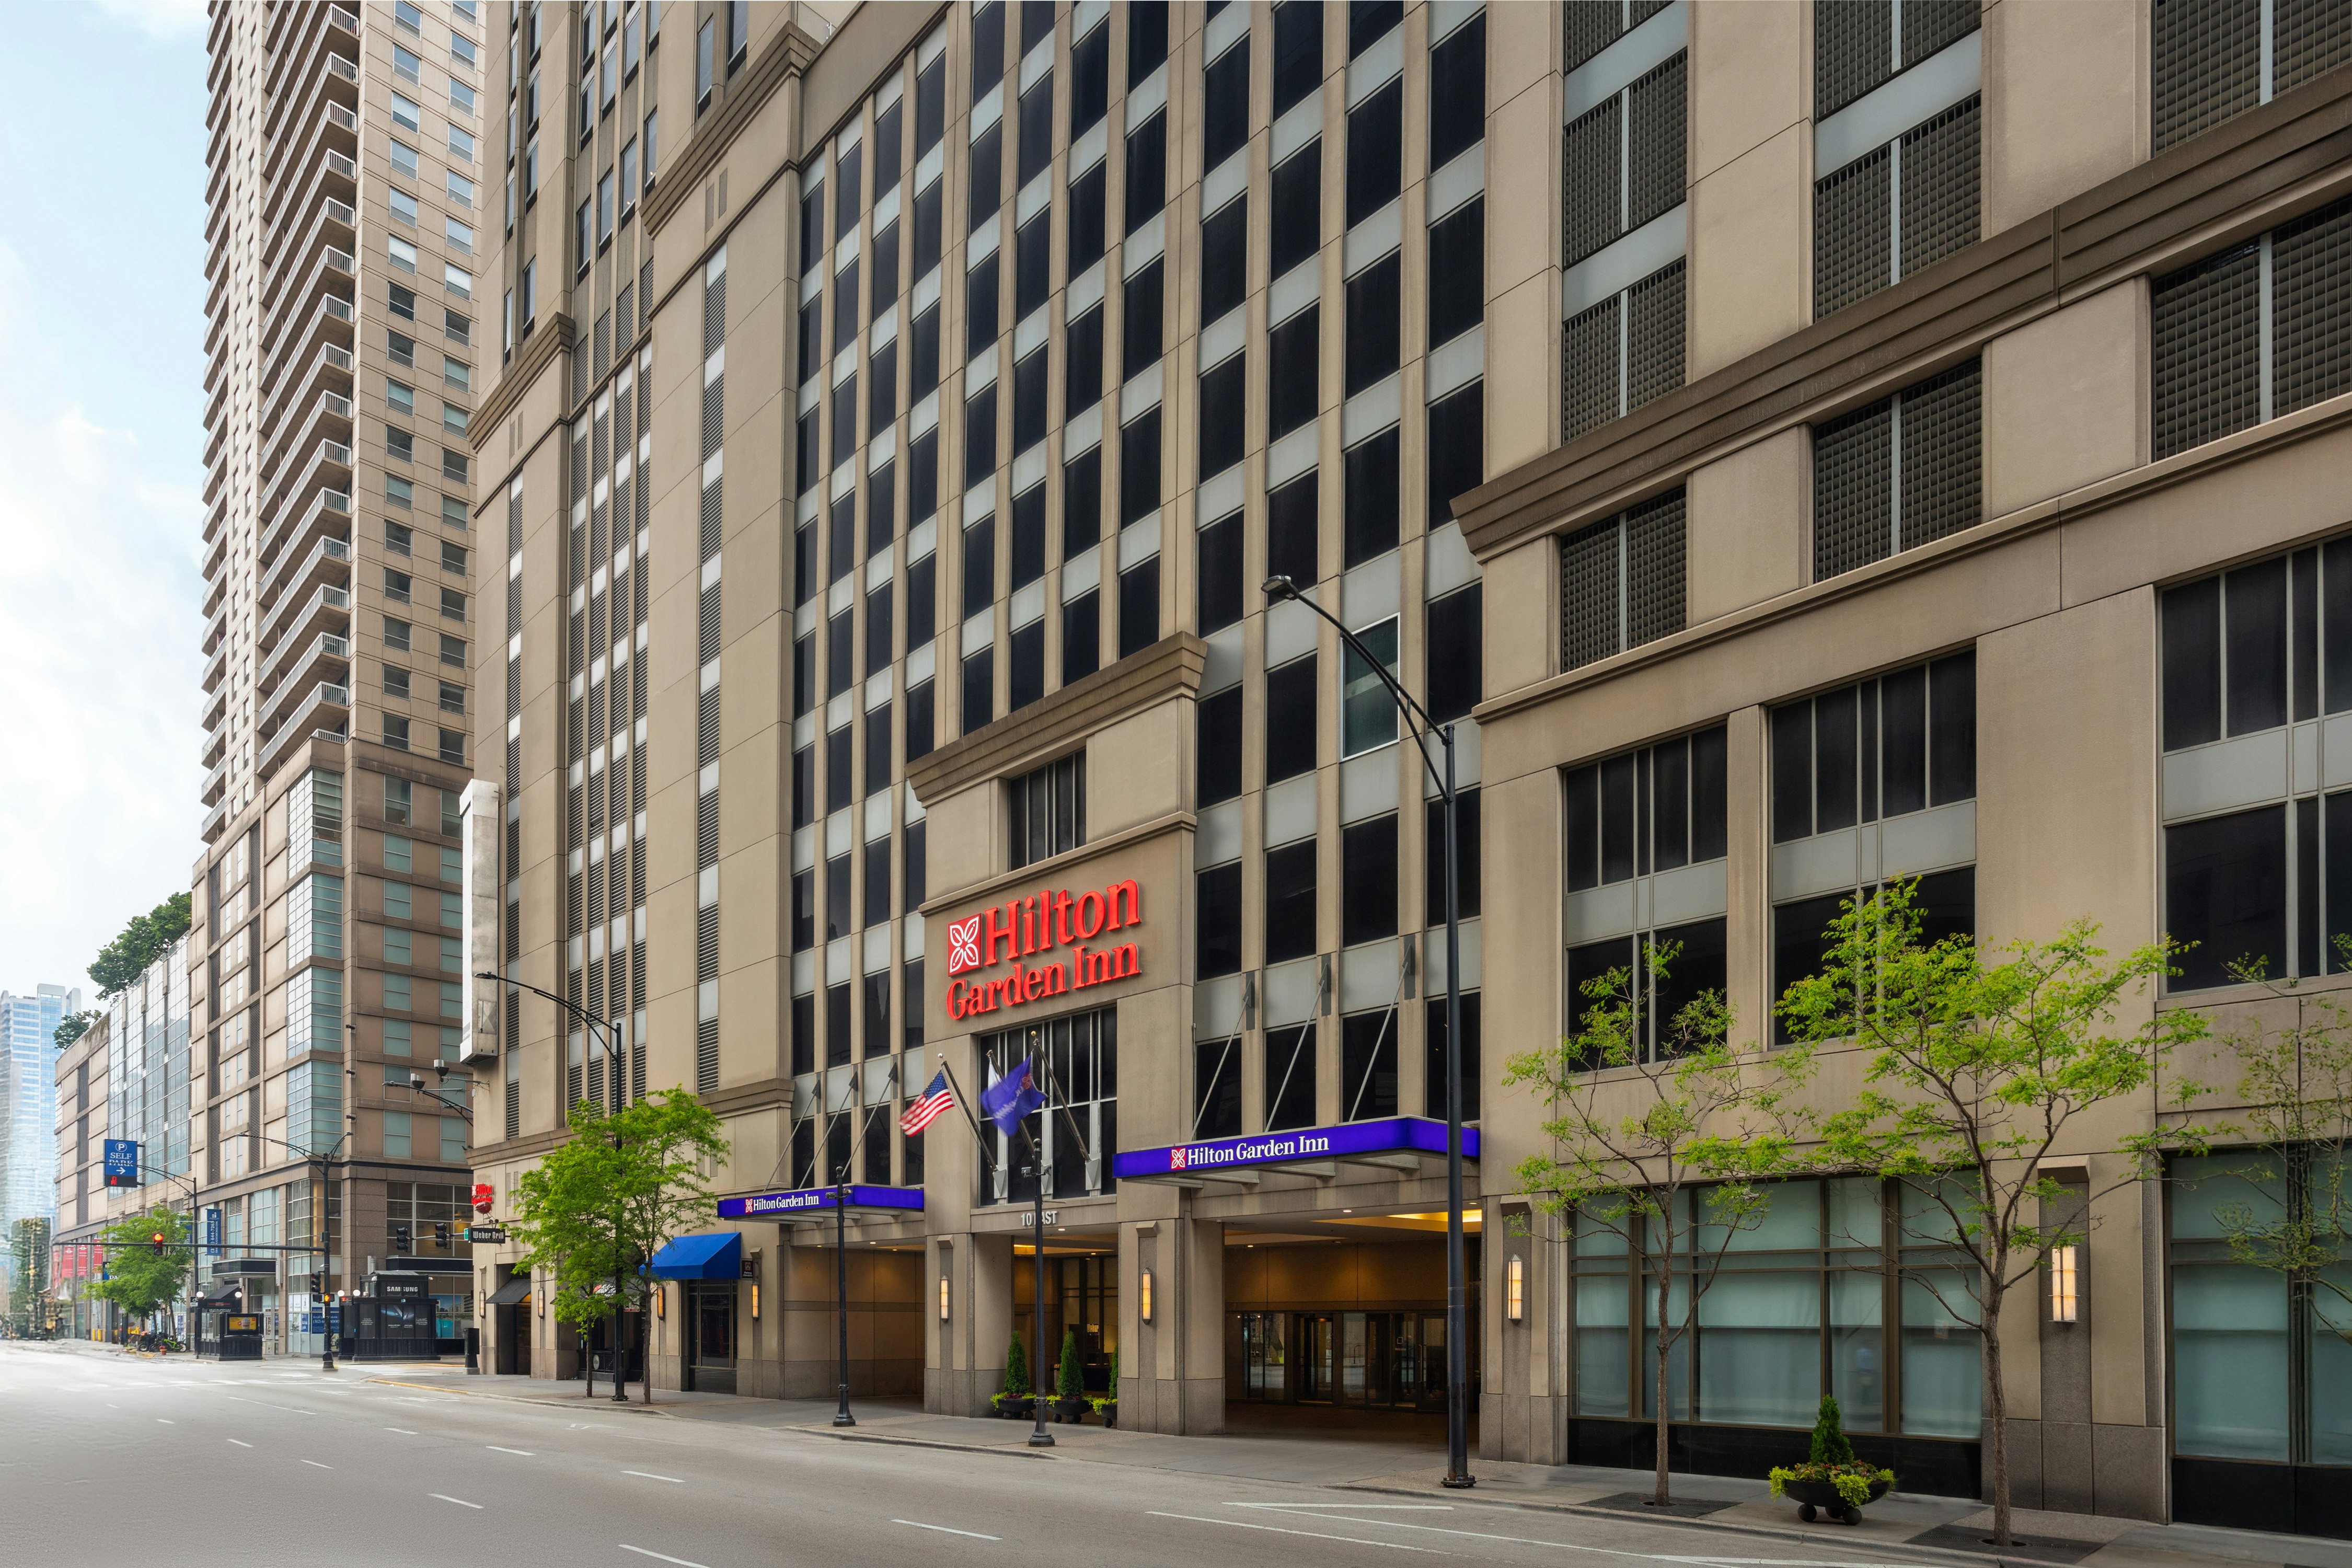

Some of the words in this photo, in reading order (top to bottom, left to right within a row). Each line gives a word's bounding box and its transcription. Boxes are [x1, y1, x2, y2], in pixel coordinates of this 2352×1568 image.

[984, 879, 1142, 966] Hilton
[947, 963, 1068, 1020] Garden
[1072, 943, 1142, 989] Inn
[1187, 1147, 1234, 1166] Hilton
[1236, 1139, 1295, 1160] Garden
[1298, 1136, 1329, 1154] Inn
[476, 1183, 492, 1196] Hilton
[753, 1198, 776, 1211] Hilton
[776, 1195, 803, 1208] Garden
[805, 1194, 819, 1206] Inn
[1021, 1213, 1032, 1226] 10
[1034, 1210, 1058, 1225] AST
